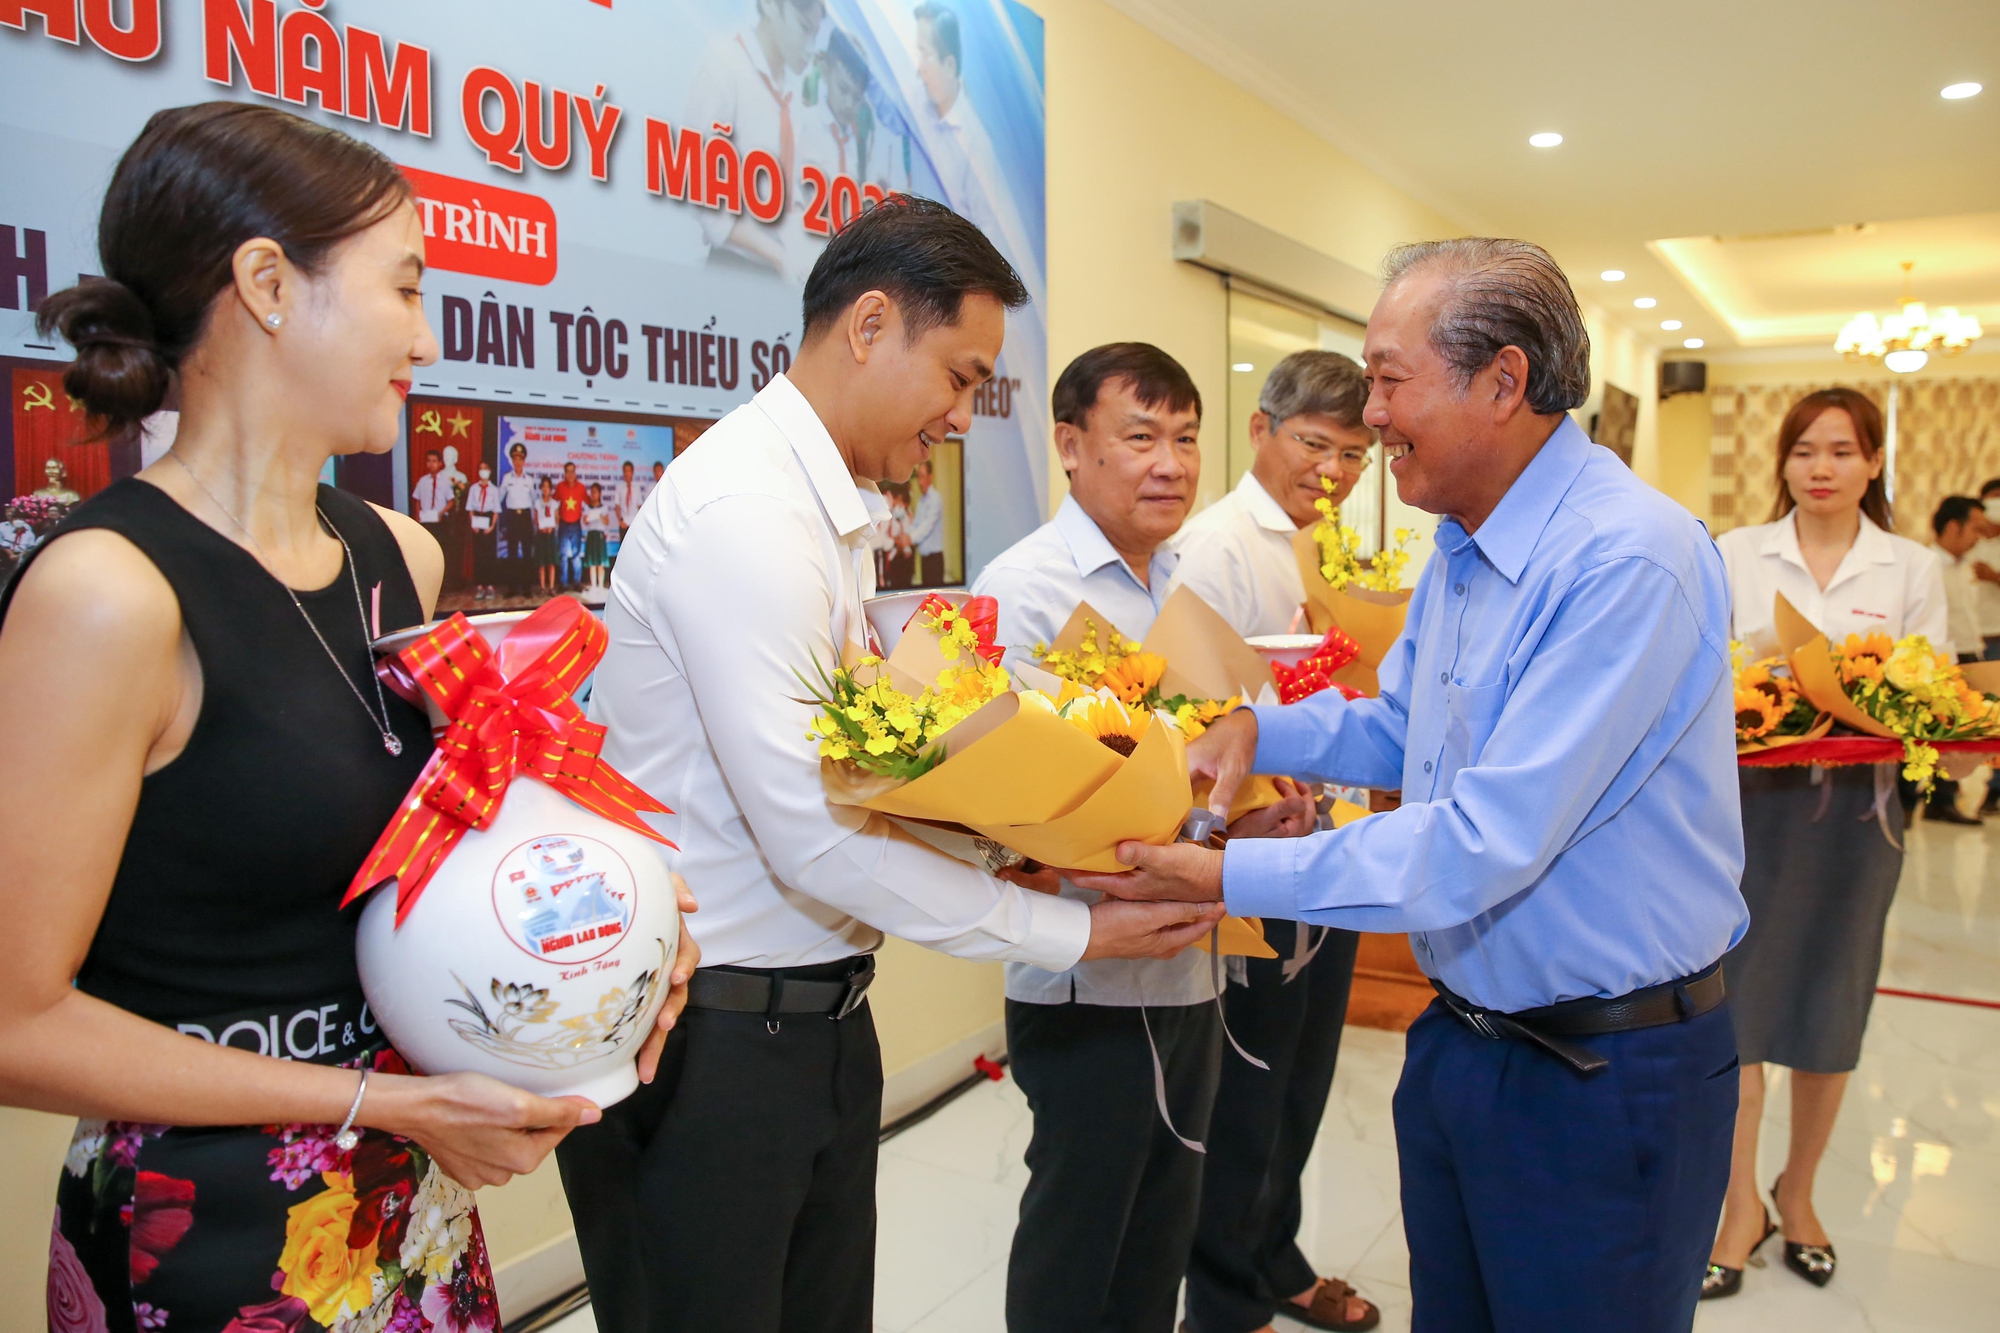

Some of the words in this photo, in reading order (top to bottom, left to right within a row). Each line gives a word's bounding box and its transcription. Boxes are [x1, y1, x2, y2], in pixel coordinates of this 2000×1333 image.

[203, 0, 432, 138] NĂM
[461, 65, 623, 182] QUÝ
[645, 115, 785, 223] MÃO
[800, 165, 907, 237] 20
[415, 196, 548, 259] TRÌNH
[442, 290, 535, 369] DÂN
[549, 305, 629, 388] TỘC
[641, 315, 739, 391] THIỂU
[751, 331, 792, 394] SỐ
[342, 1021, 356, 1046] &
